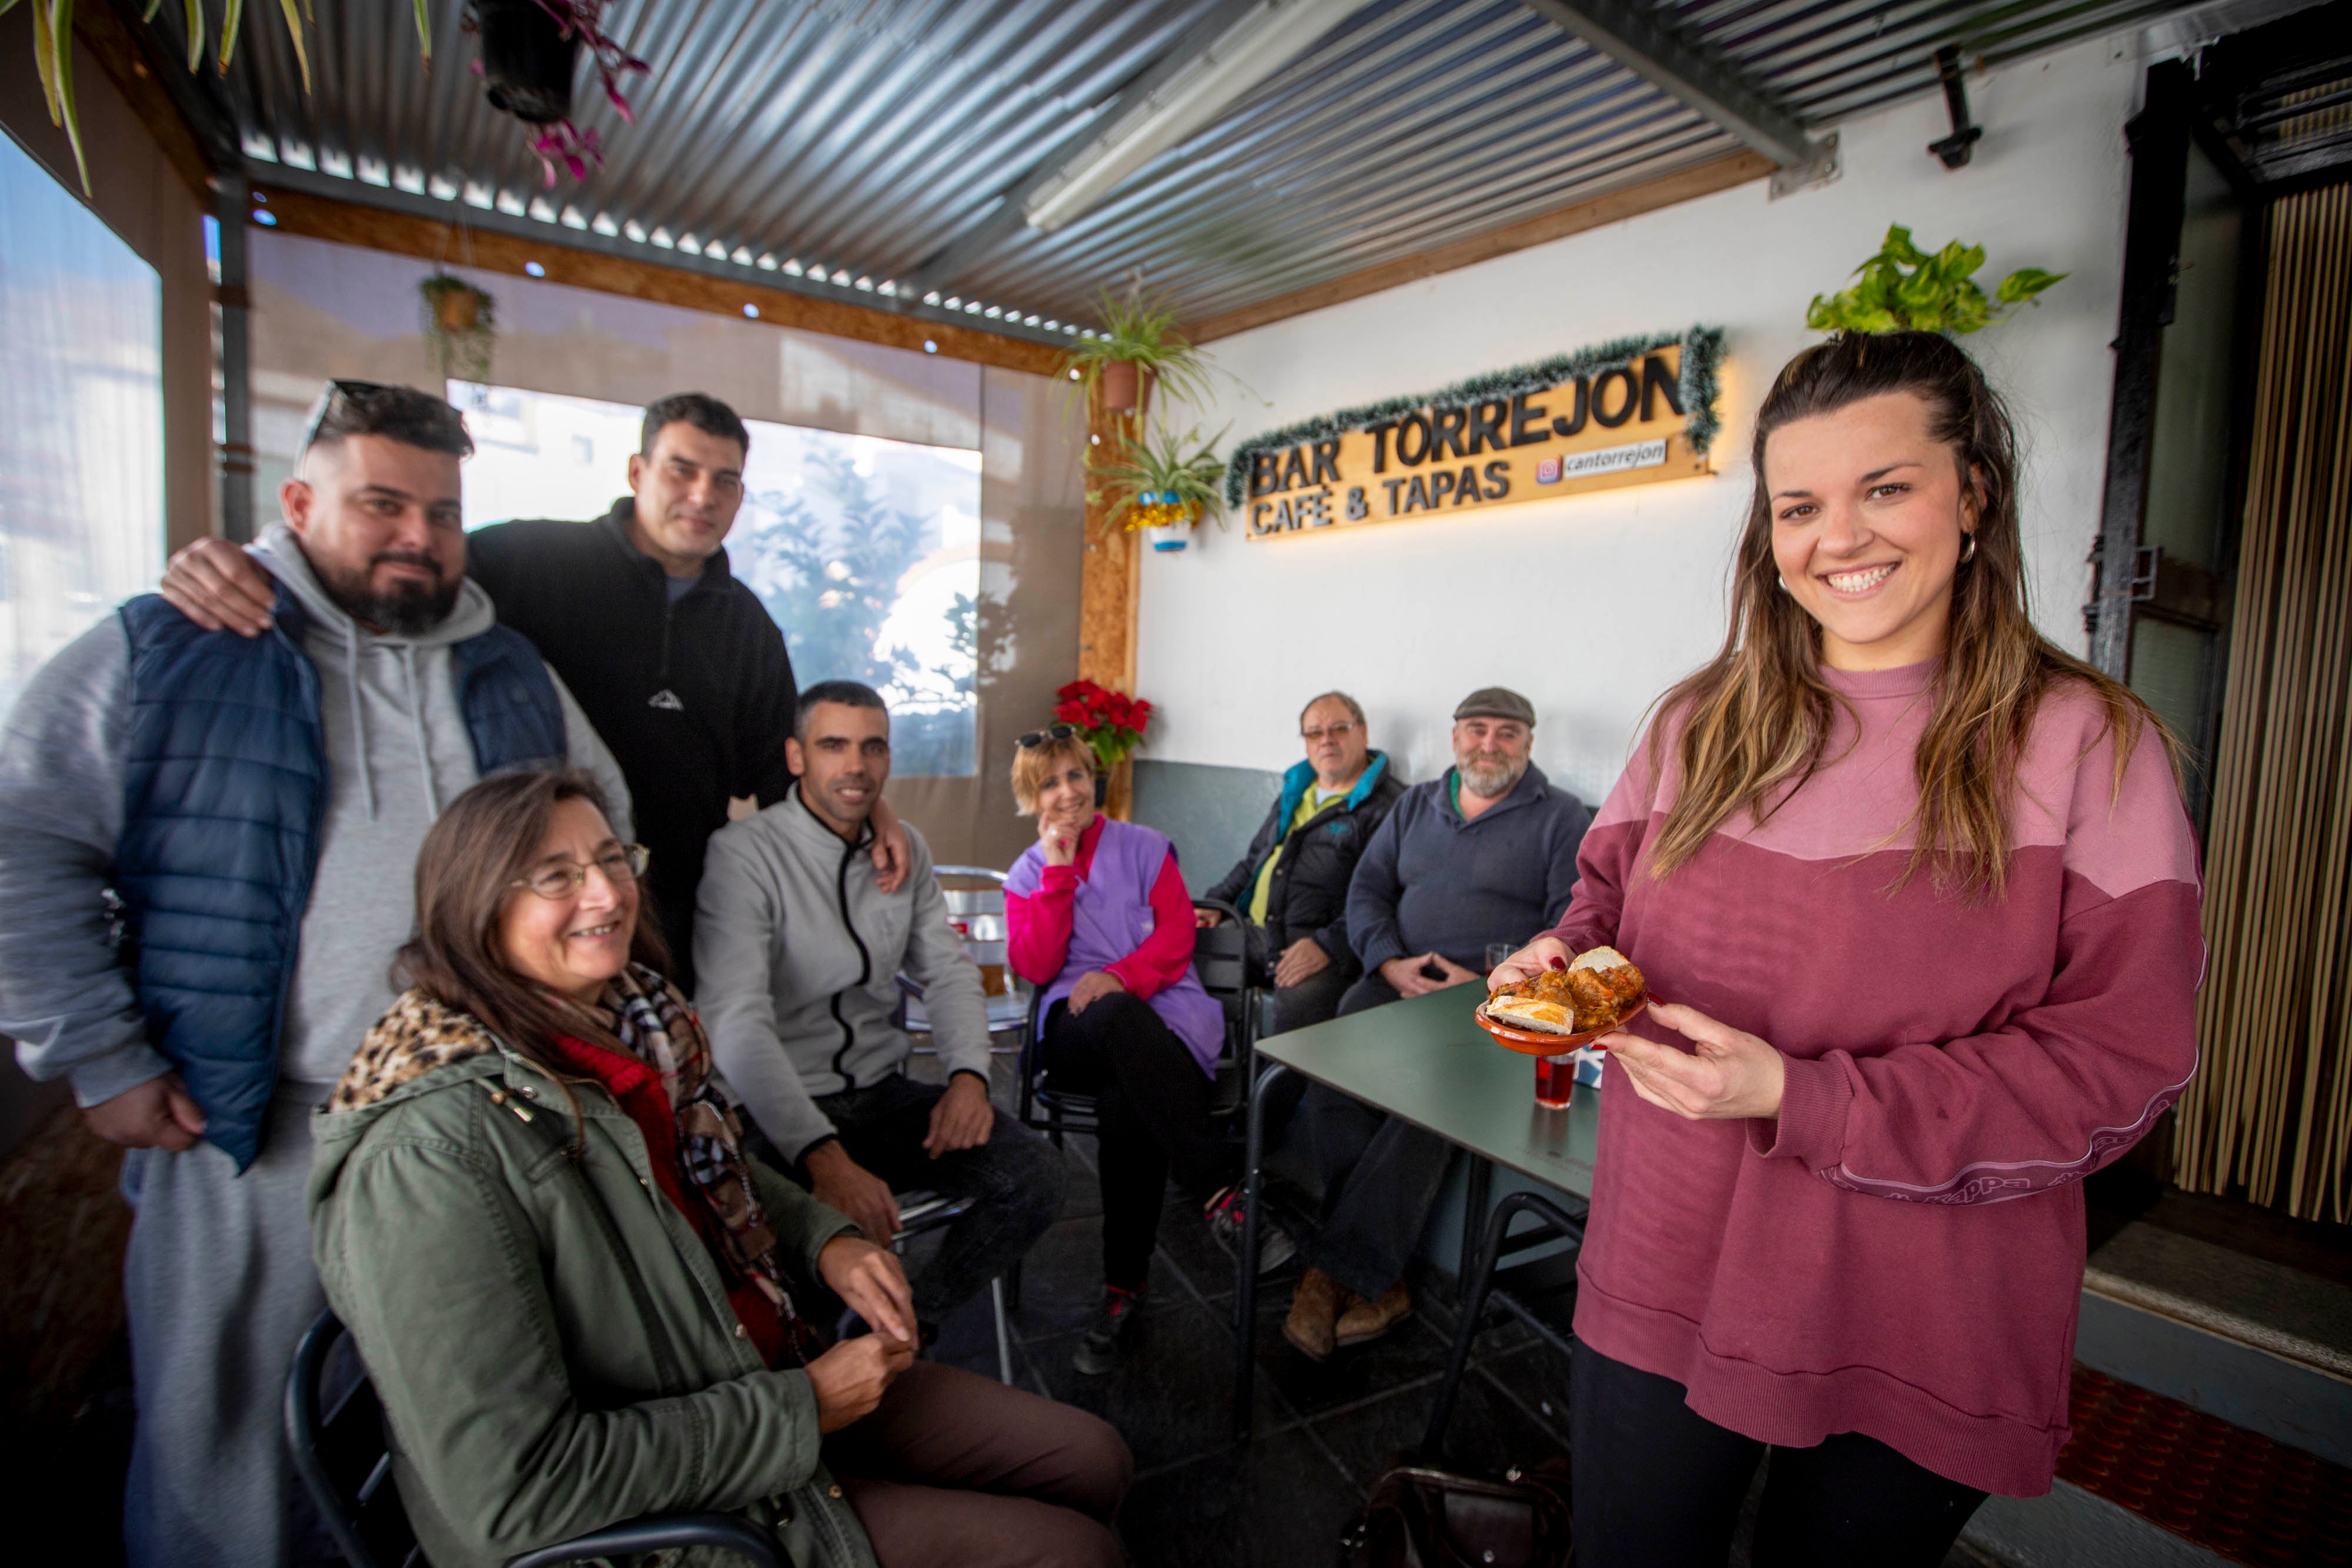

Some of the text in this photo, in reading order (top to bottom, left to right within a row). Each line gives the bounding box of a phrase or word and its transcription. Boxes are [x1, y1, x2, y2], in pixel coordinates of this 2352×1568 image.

[1251, 440, 1341, 497] BAR
[1566, 443, 1664, 471] cantorrejon
[1345, 487, 1368, 520] &
[1383, 461, 1509, 515] TAPAS
